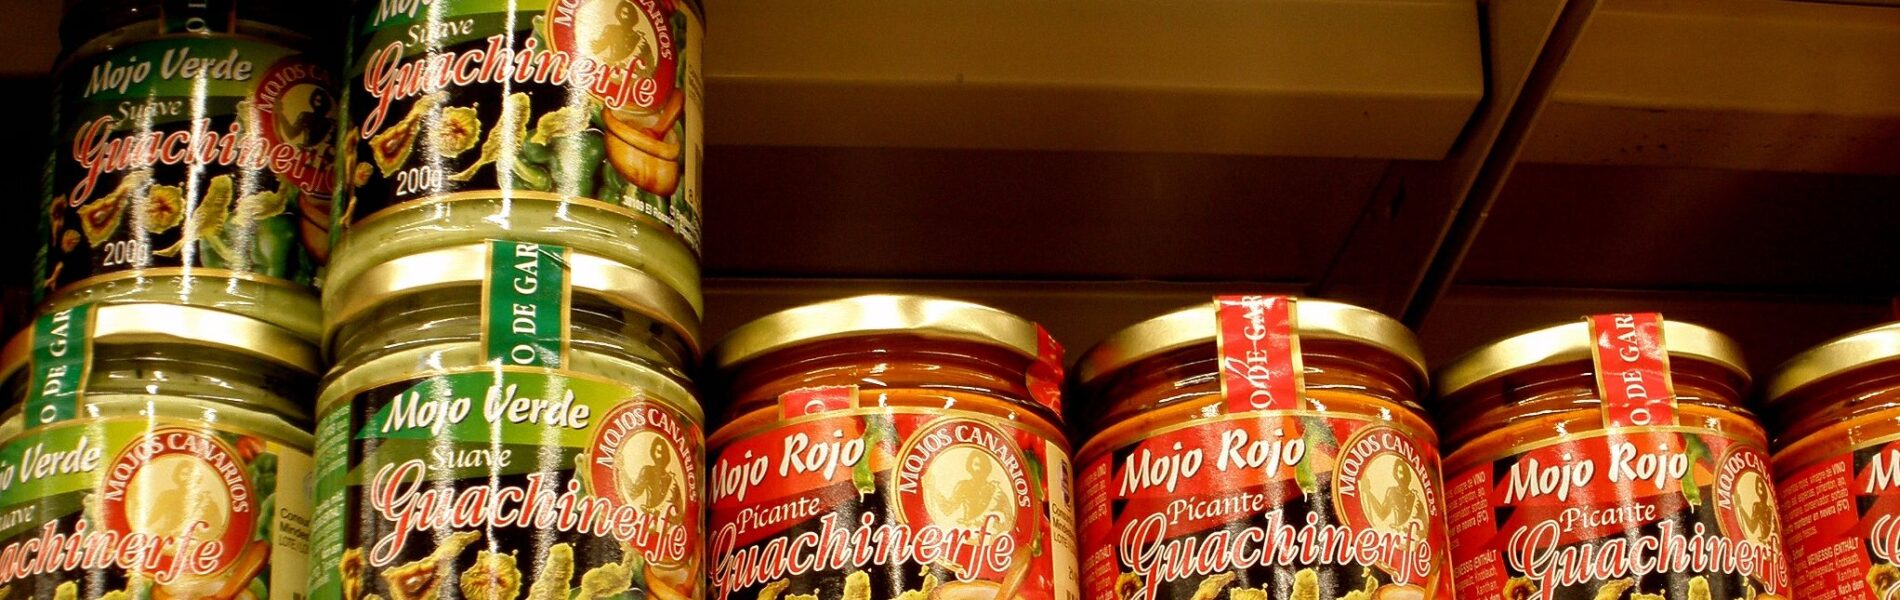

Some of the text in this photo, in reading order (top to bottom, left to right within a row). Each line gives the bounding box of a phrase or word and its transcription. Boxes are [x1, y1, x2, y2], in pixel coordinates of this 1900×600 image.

[405, 19, 474, 47] Suave
[84, 48, 253, 98] Mojo Verde
[361, 34, 657, 141] Guachinerfe
[116, 99, 182, 125] Suave
[396, 165, 442, 197] 200g
[104, 240, 149, 267] 200g
[511, 243, 540, 365] O DE GAR
[42, 364, 69, 396] DE
[1246, 349, 1270, 380] DE
[1614, 313, 1652, 426] O DE GAR
[40, 404, 57, 424] O
[381, 384, 590, 436] Mojo Verde
[1250, 389, 1273, 409] O
[20, 436, 102, 483] Verde
[105, 433, 164, 502] MOJOS
[167, 432, 249, 513] CANARIOS
[429, 445, 511, 471] Suave
[596, 407, 698, 502] MOJOS CANARIOS
[710, 430, 865, 504] Mojo Rojo
[899, 426, 953, 495] MOJOS
[954, 425, 1031, 509] CANARIOS
[1119, 428, 1305, 498] Mojo Rojo
[1338, 433, 1437, 517] MOJOS CANARIOS
[1504, 453, 1595, 505] Mojo
[1608, 442, 1689, 490] Rojo
[1717, 452, 1745, 511] MOJOS
[369, 459, 688, 568] Guachinerfe
[736, 493, 820, 535] Picante
[1167, 491, 1264, 525] Picante
[1559, 503, 1656, 533] Picante
[709, 512, 1014, 600] Guachinerfe
[1119, 510, 1431, 600] Guachinerfe
[1508, 518, 1788, 600] Guachinerfe
